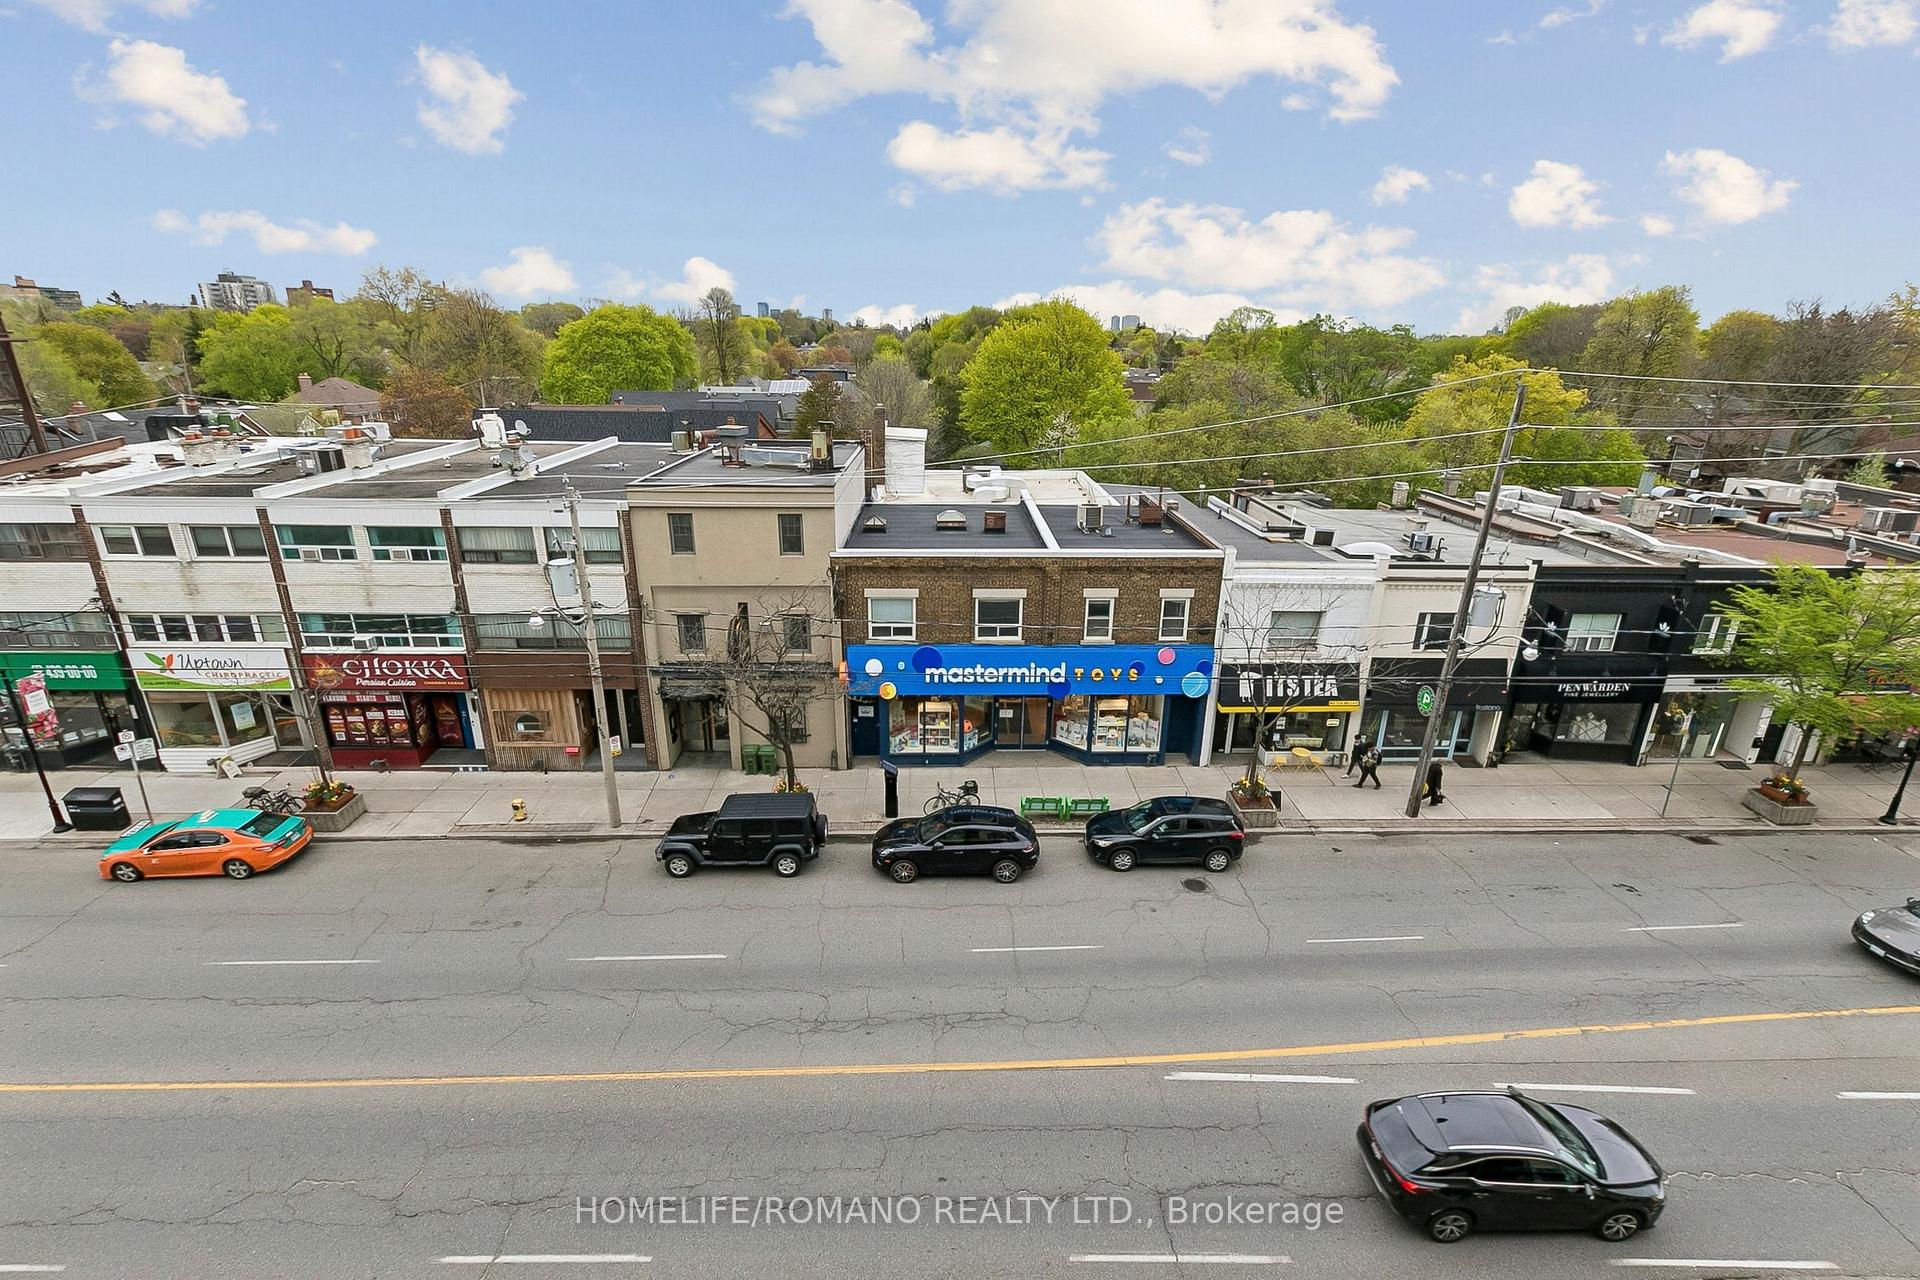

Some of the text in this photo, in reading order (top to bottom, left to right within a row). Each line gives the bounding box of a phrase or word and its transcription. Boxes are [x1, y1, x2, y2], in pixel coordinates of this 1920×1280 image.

[177, 653, 245, 676] Uptown
[205, 671, 282, 679] CHIROPRACTIC
[925, 661, 1138, 683] mastermind TOYS
[355, 678, 387, 687] Persian
[387, 678, 417, 687] Cuisine
[1558, 681, 1631, 692] PENWARDEN
